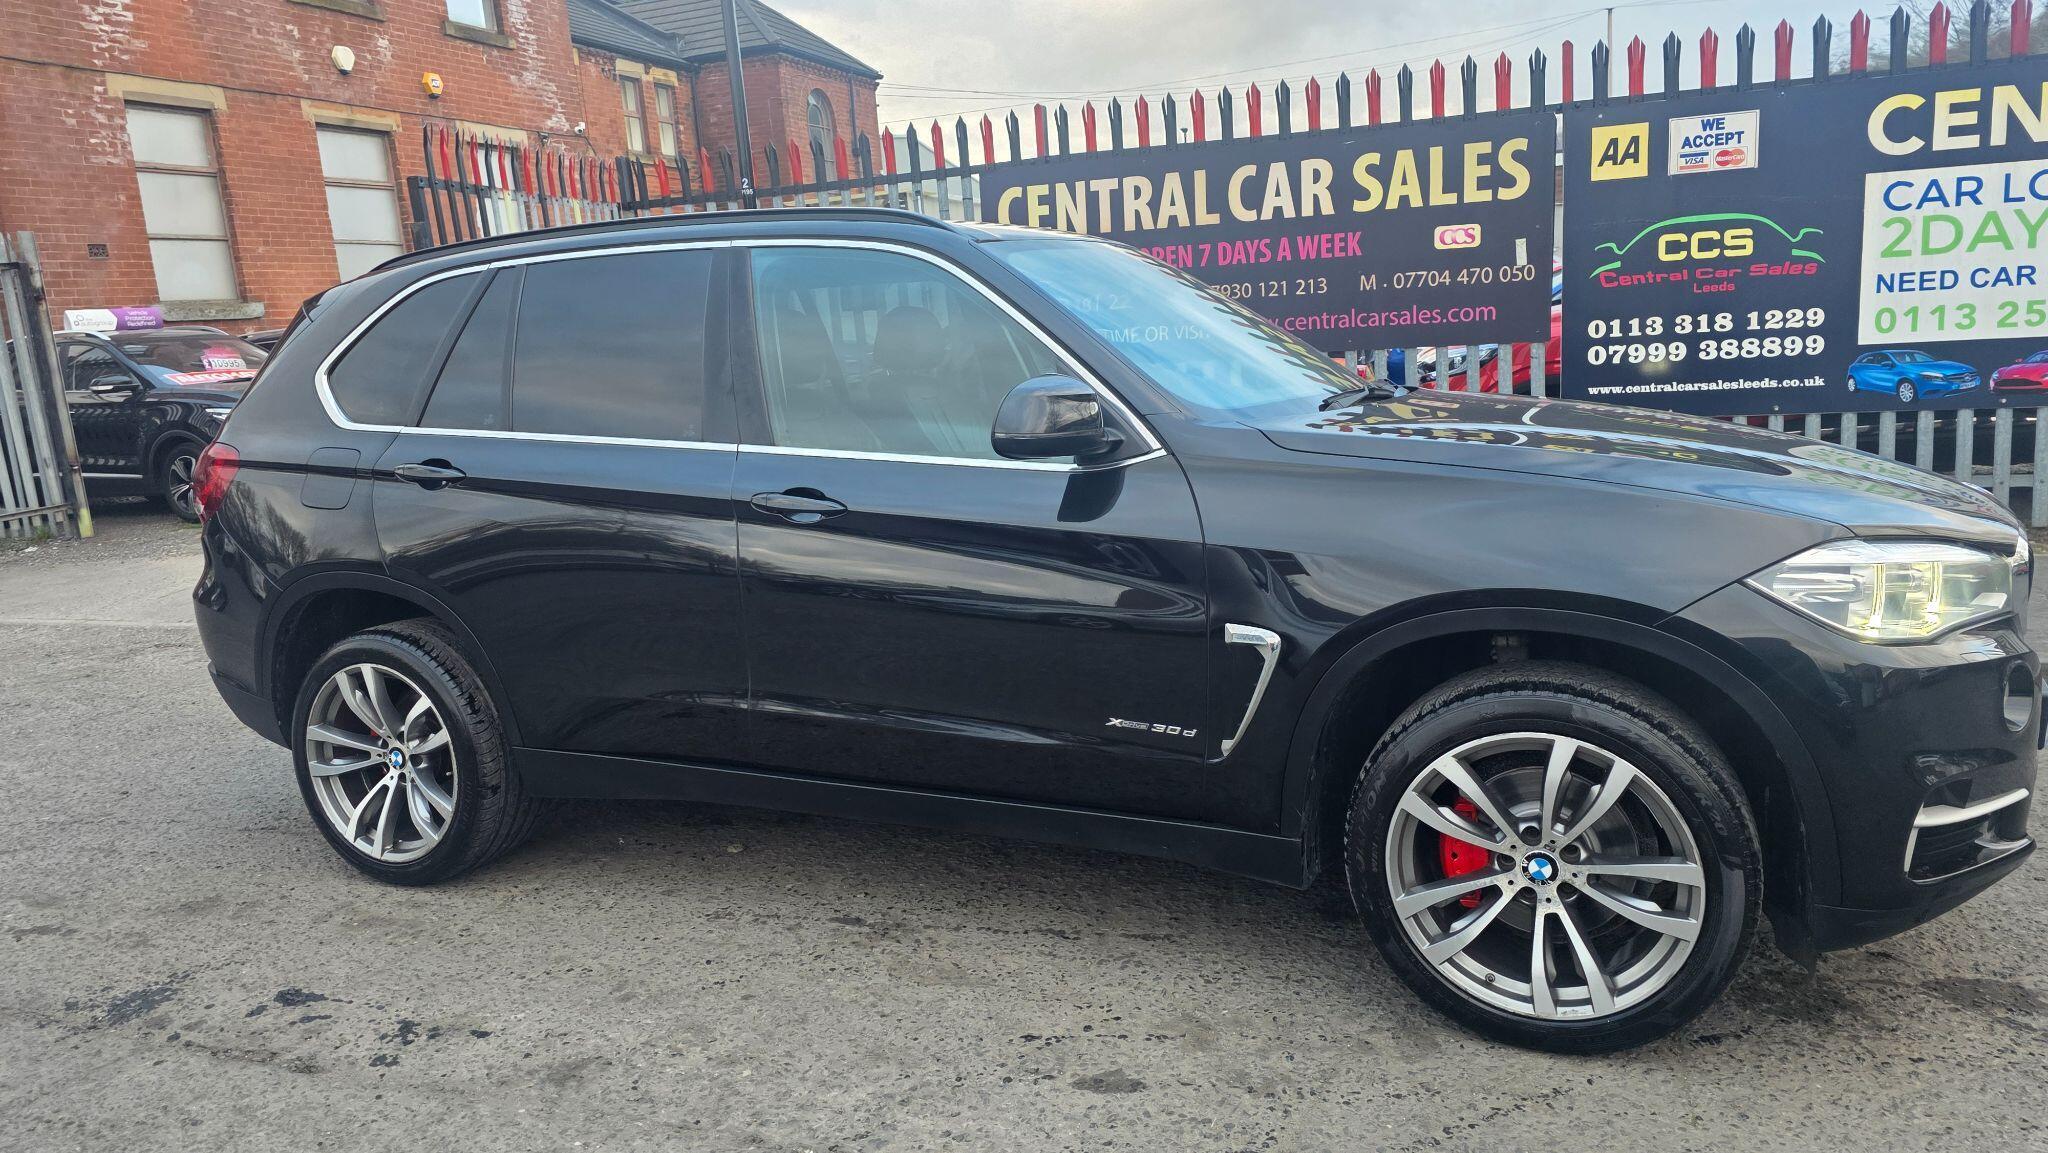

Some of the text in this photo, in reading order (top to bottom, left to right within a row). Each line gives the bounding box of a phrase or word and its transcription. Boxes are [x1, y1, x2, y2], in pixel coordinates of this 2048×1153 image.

[1701, 117, 1726, 132] WE
[1867, 81, 2048, 156] CEN
[1597, 135, 1641, 168] AA
[1681, 131, 1745, 149] ACCEPT
[1684, 157, 1705, 165] VISA
[741, 178, 749, 188] 2
[998, 137, 1531, 234] CENTRAL CAR SALES
[1883, 176, 1984, 212] CAR
[1438, 227, 1476, 246] CCS
[1658, 228, 1754, 262] CCS
[1880, 206, 2048, 258] 2DAY
[1199, 244, 1213, 268] 7
[1217, 238, 1272, 266] DAYS
[1276, 237, 1292, 262] A
[1297, 231, 1364, 260] WEEK
[1258, 281, 1288, 298] 121
[1296, 277, 1328, 295] 213
[1359, 275, 1377, 291] M
[1393, 270, 1451, 289] 07704
[1457, 267, 1493, 285] 470
[1499, 264, 1536, 283] 050
[1600, 261, 1818, 288] Central Car Sales
[1693, 281, 1736, 294] Leeds
[1875, 265, 2037, 294] NEED CAR
[1145, 326, 1169, 342] OR
[1587, 307, 1826, 339] 0113 318 1229
[1875, 303, 1977, 334] 0113
[1587, 335, 1826, 366] 07999 388899
[1587, 376, 1826, 395] www.centralcarsalesleeds.co.uk
